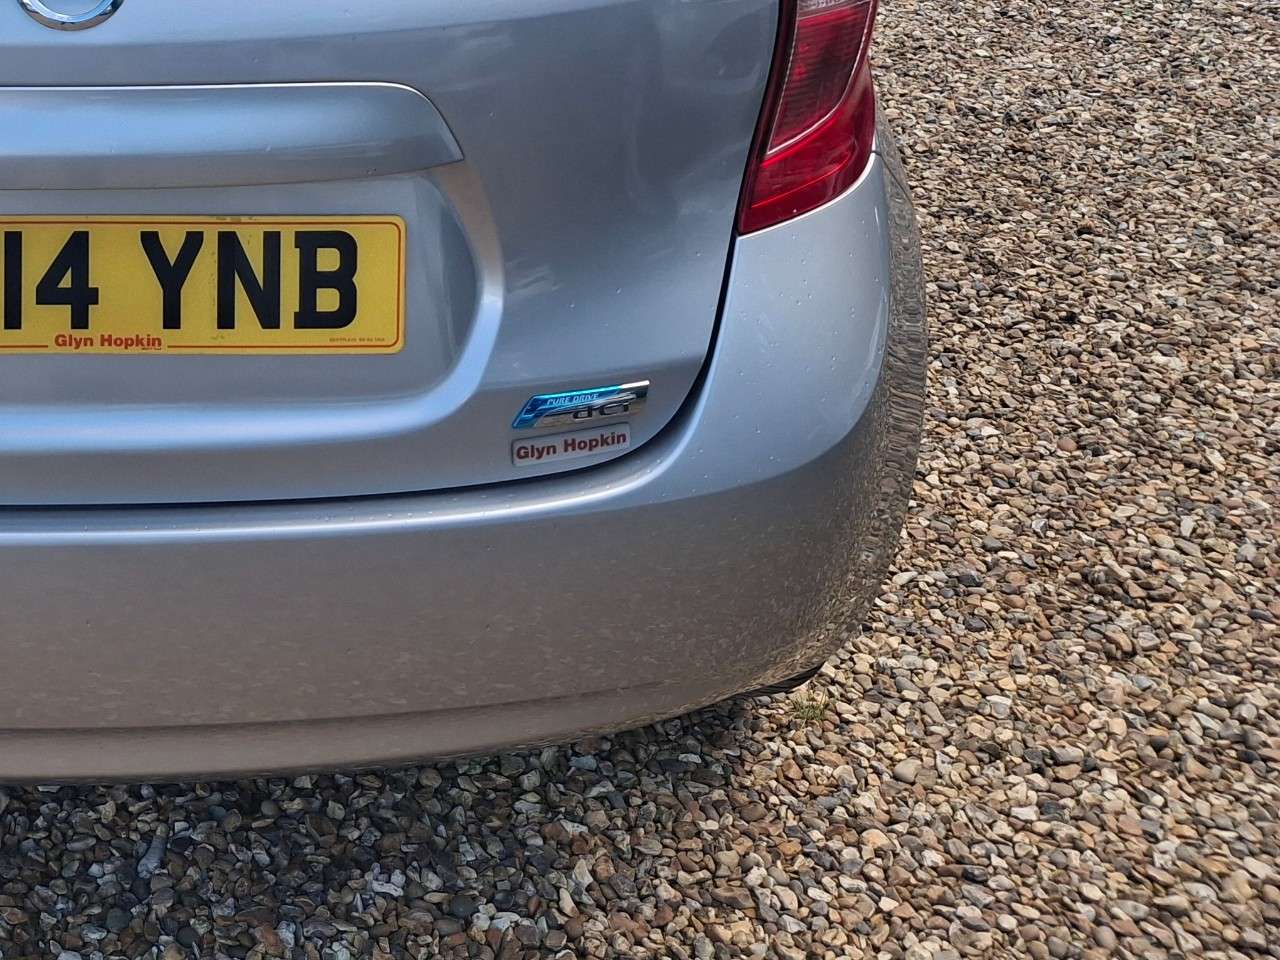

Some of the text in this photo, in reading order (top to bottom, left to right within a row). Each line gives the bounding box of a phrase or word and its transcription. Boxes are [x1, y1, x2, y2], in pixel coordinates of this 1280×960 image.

[139, 230, 358, 331] YNB
[54, 333, 162, 349] Glyn Hopkin
[546, 393, 600, 406] PURE DRIVE
[516, 432, 627, 460] Glyn Hopkin
